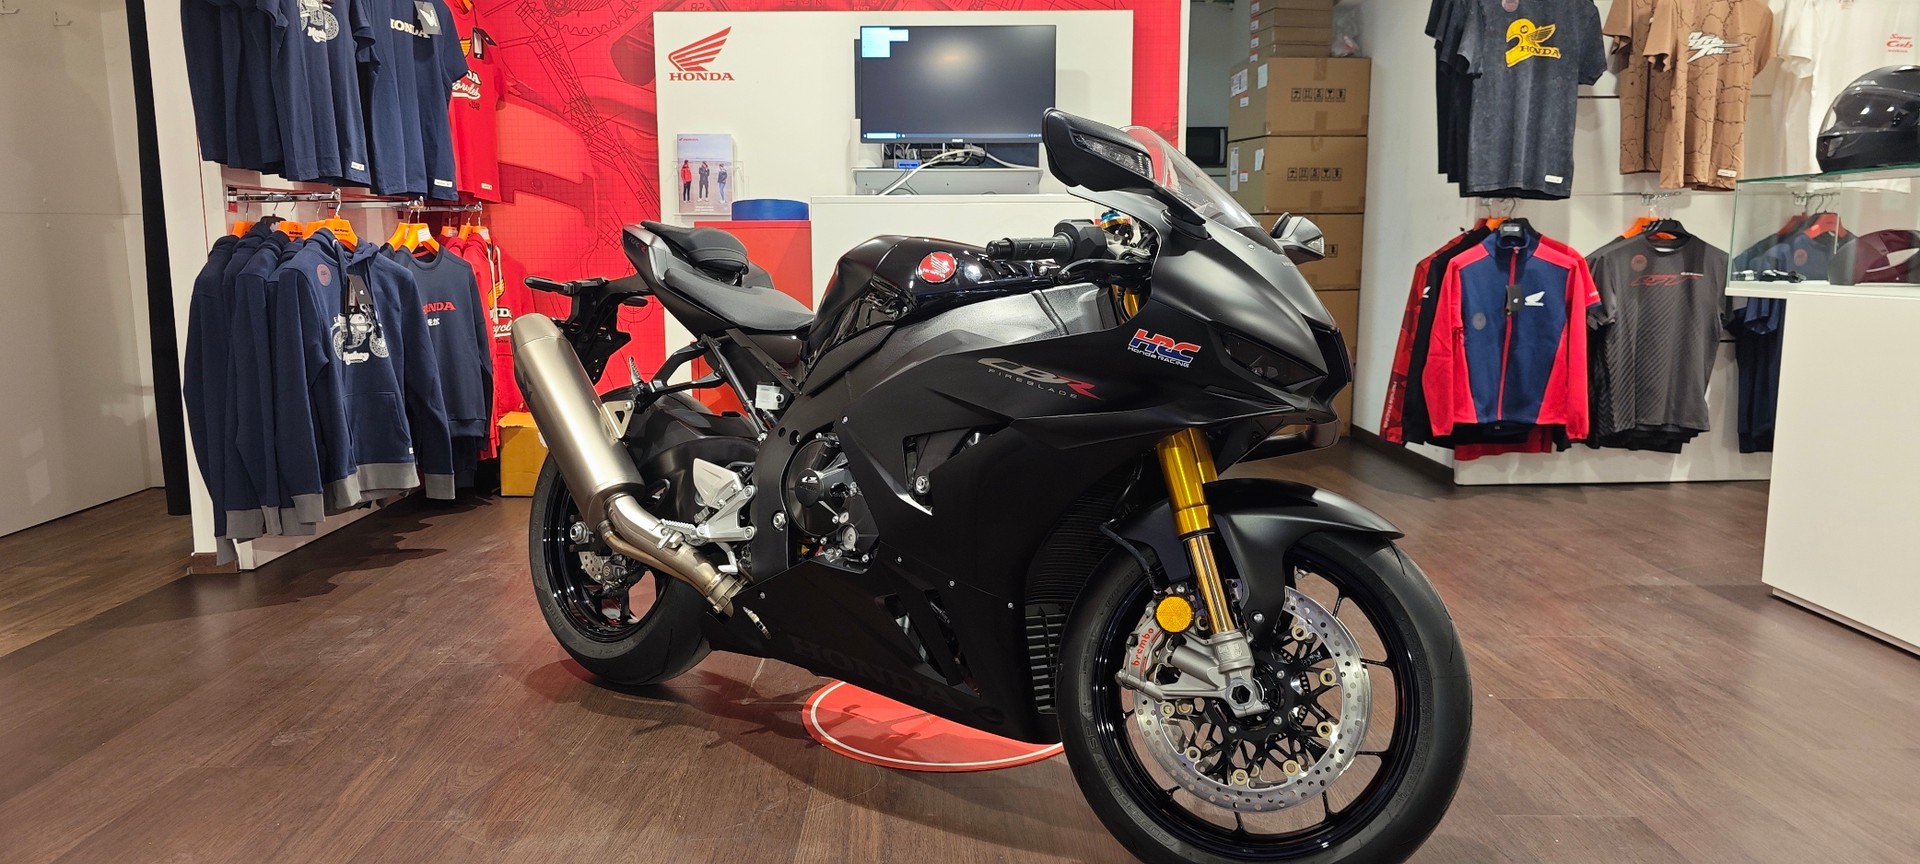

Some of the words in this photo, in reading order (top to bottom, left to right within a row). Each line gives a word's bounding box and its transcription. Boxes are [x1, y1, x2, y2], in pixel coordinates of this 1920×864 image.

[1520, 46, 1559, 57] HONDA
[669, 72, 735, 81] HONDA
[1127, 346, 1157, 360] Honda
[1157, 355, 1190, 368] RACING
[1128, 328, 1201, 363] HRC
[988, 368, 1078, 399] FIREBLADE
[1131, 628, 1154, 667] brembo
[787, 634, 964, 712] HONDA
